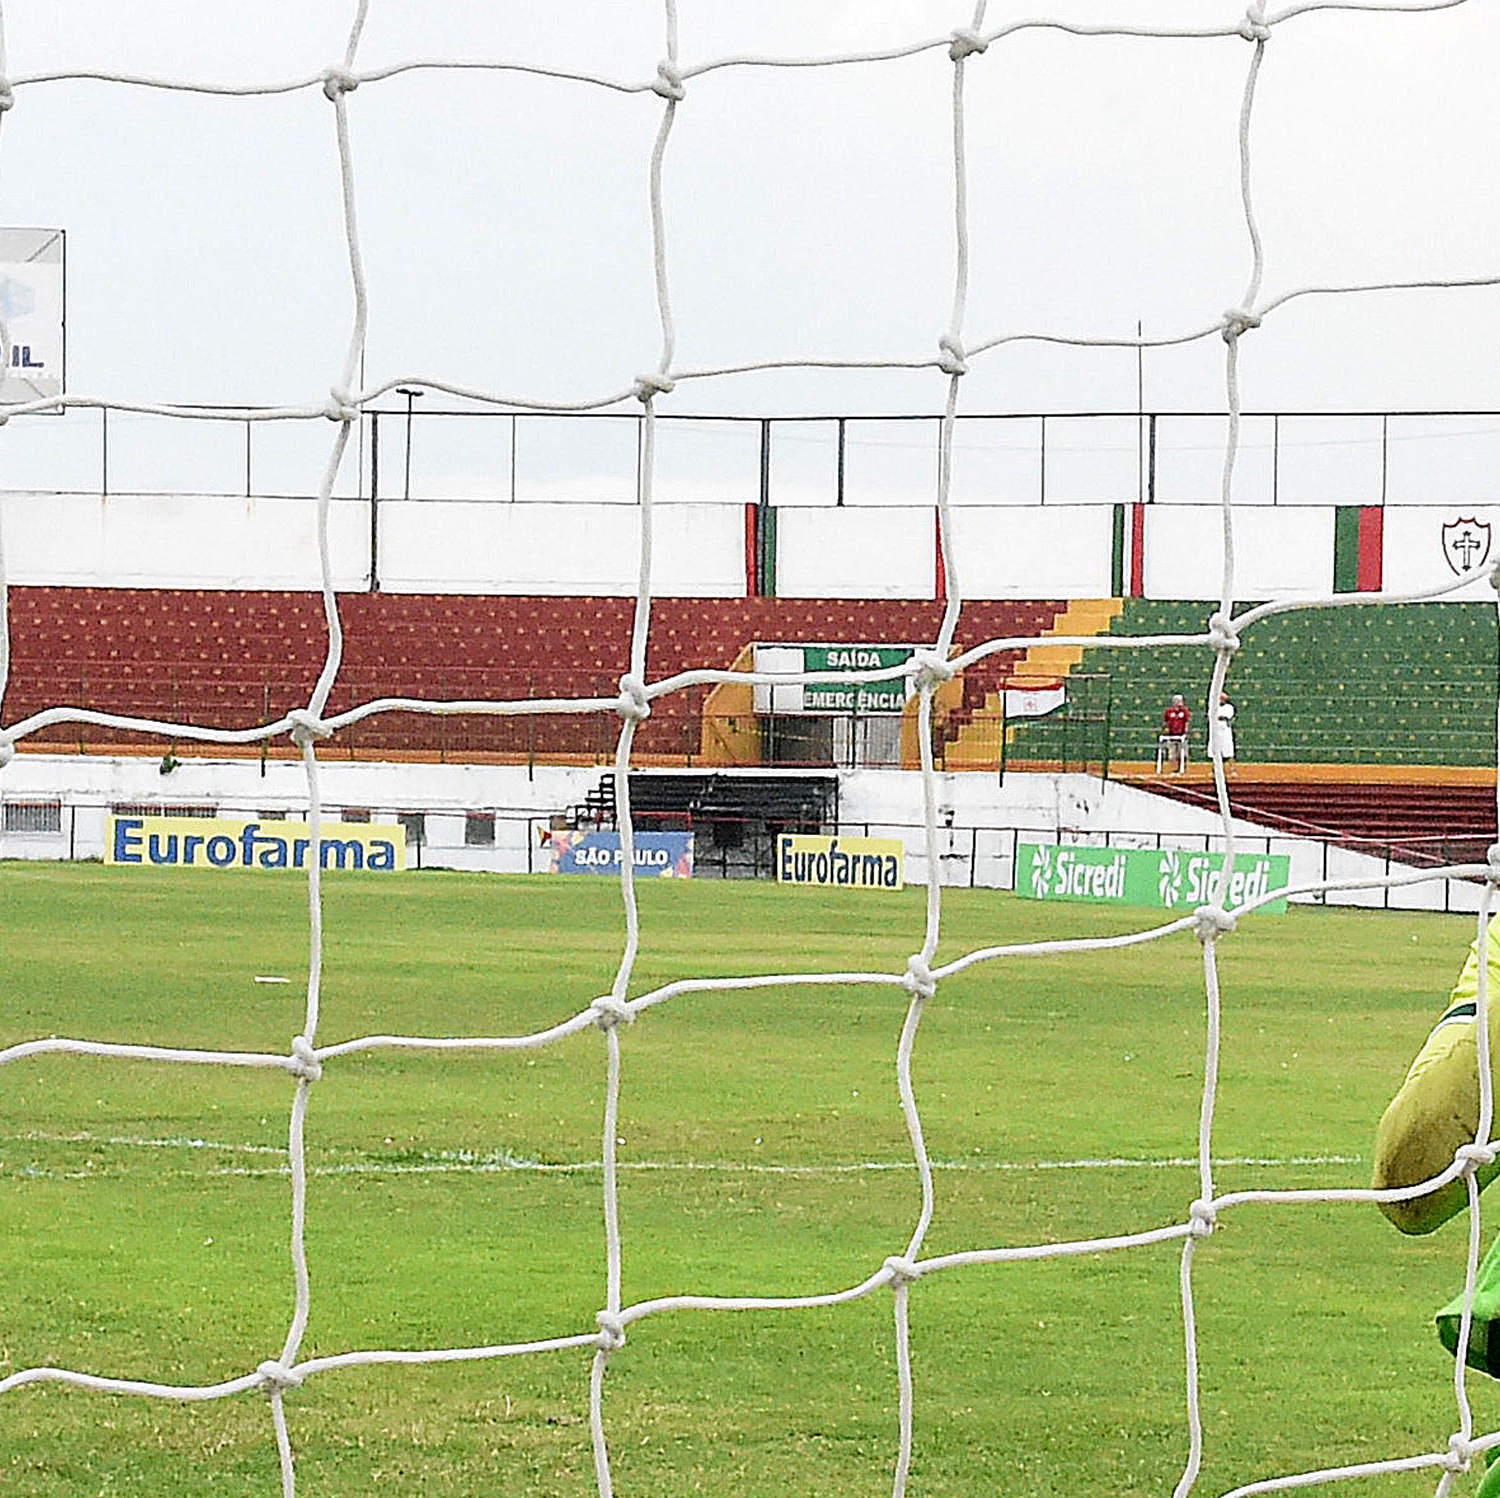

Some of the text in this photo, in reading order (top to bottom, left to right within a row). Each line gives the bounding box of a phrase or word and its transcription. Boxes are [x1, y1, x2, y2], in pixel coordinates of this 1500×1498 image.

[827, 649, 882, 668] SAÍDA
[113, 819, 397, 871] Eurofarma
[575, 847, 610, 865] SÃO
[781, 838, 898, 887] Eurofarma
[1055, 852, 1127, 898] Sicredi
